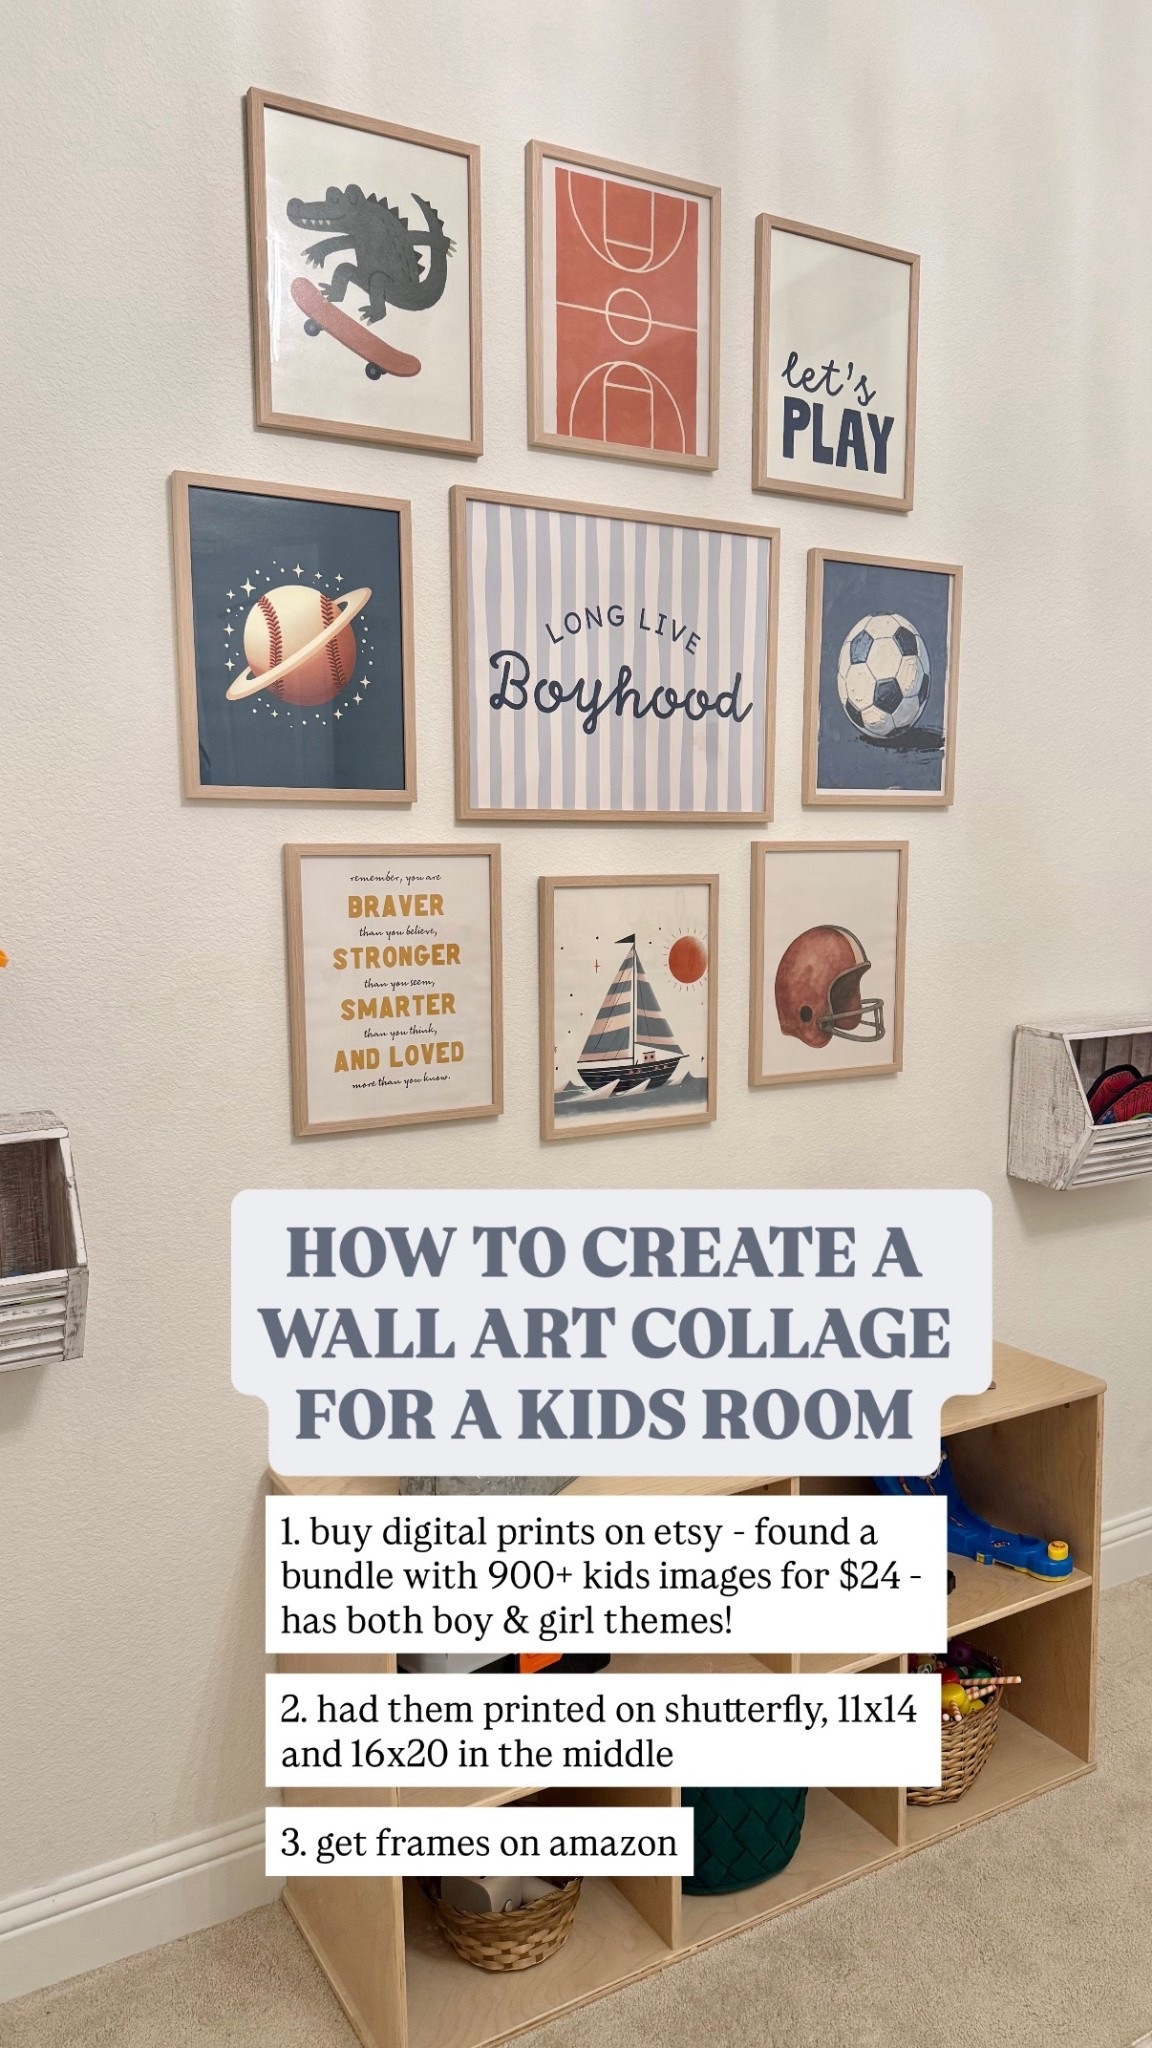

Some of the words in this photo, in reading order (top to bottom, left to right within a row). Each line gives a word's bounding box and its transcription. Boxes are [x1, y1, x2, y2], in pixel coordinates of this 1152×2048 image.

[782, 352, 876, 406] let's
[783, 396, 894, 474] PLAY
[545, 605, 625, 644] LONG
[639, 608, 702, 655] LIVE
[489, 650, 753, 734] Boyhood
[350, 871, 403, 883] remember,
[405, 876, 424, 886] you
[348, 894, 444, 918] BRAVER
[360, 926, 384, 937] than
[386, 931, 404, 940] you
[406, 925, 438, 937] believe,
[333, 944, 461, 970] STRONGER
[364, 978, 388, 988] than
[390, 980, 409, 991] you
[410, 979, 436, 988] seem,
[341, 993, 455, 1020] SMARTER
[364, 1028, 388, 1038] than
[389, 1030, 408, 1040] you
[409, 1023, 438, 1036] think,
[334, 1048, 380, 1072] AND
[389, 1041, 464, 1067] LOVED
[352, 1081, 377, 1089] more
[378, 1076, 402, 1087] than
[403, 1078, 422, 1088] you
[423, 1072, 451, 1082] know.
